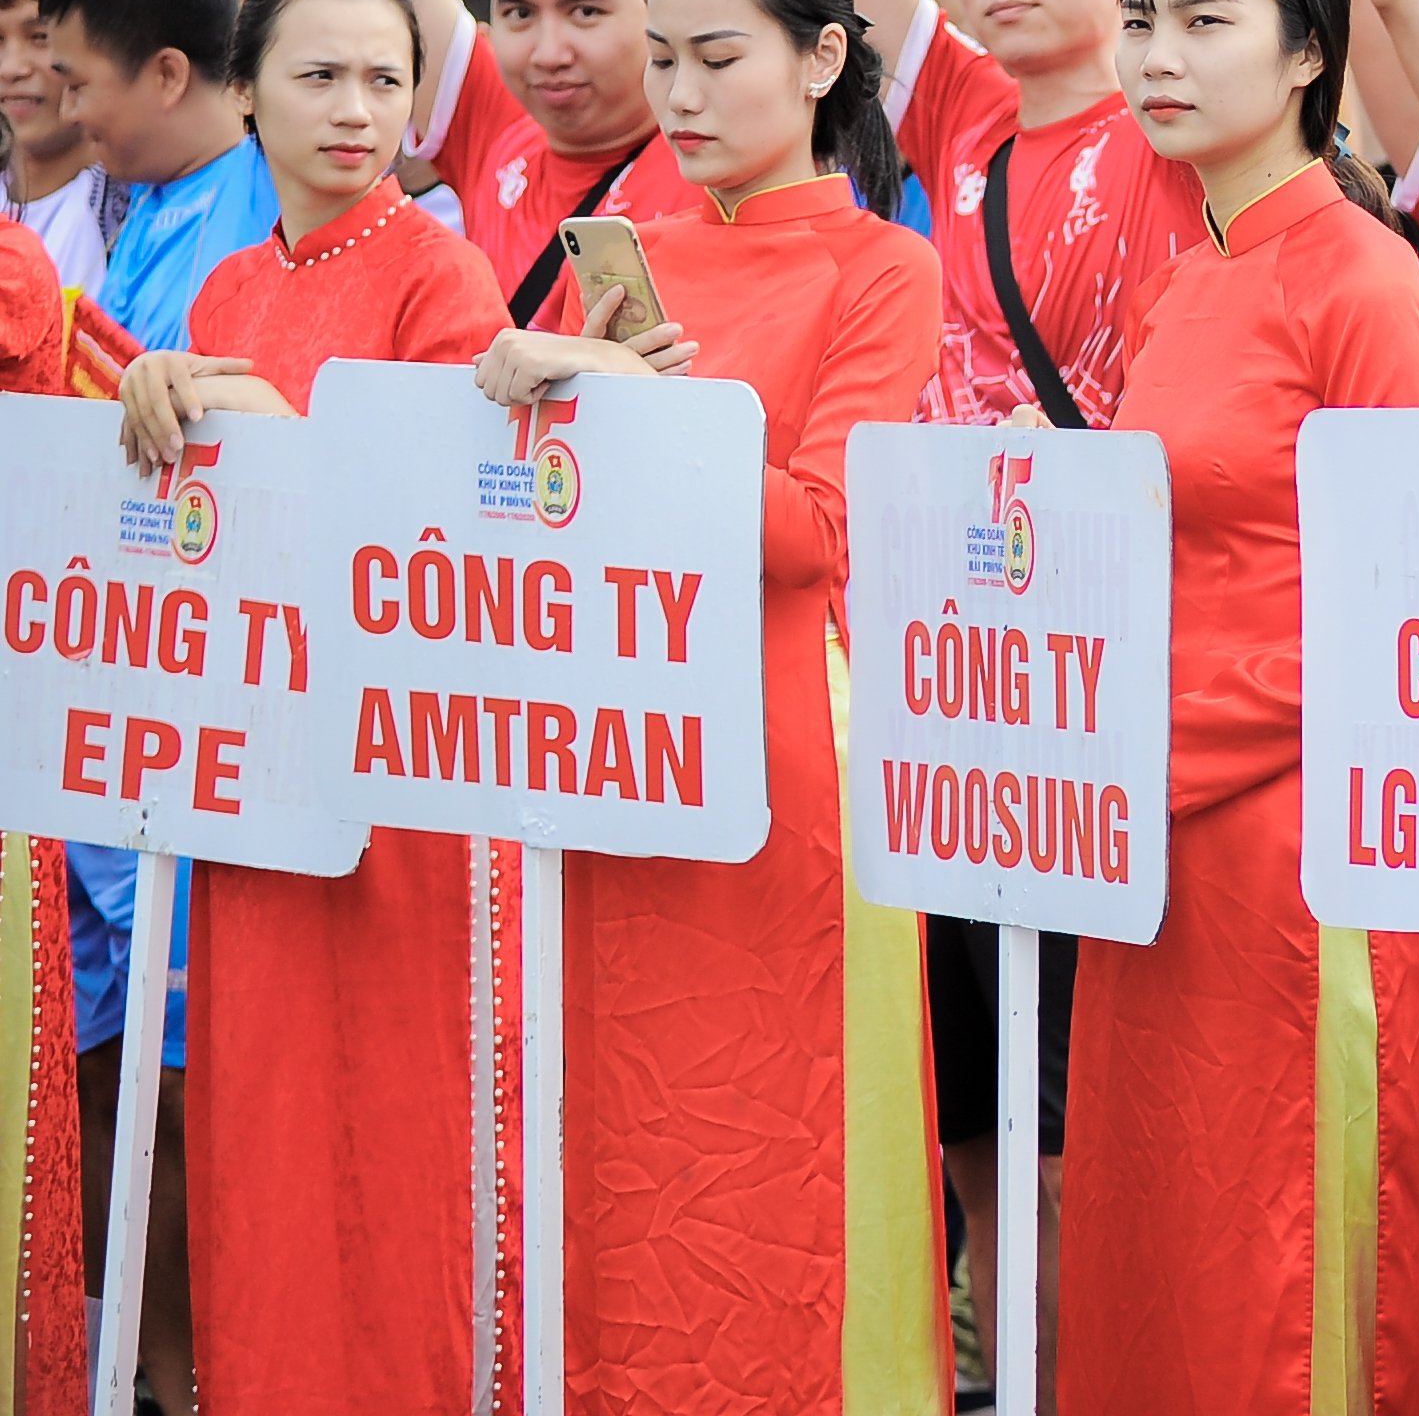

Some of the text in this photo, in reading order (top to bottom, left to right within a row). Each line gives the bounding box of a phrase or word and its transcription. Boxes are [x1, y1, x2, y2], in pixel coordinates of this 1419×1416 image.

[4, 556, 213, 677] CÔNG
[352, 527, 703, 664] CÔNG TY
[904, 599, 1105, 733] CÔNG TY
[62, 708, 247, 815] EPE
[354, 687, 704, 808] AMTRAN
[882, 759, 1129, 884] WOOSUNG
[1349, 767, 1418, 869] LG
